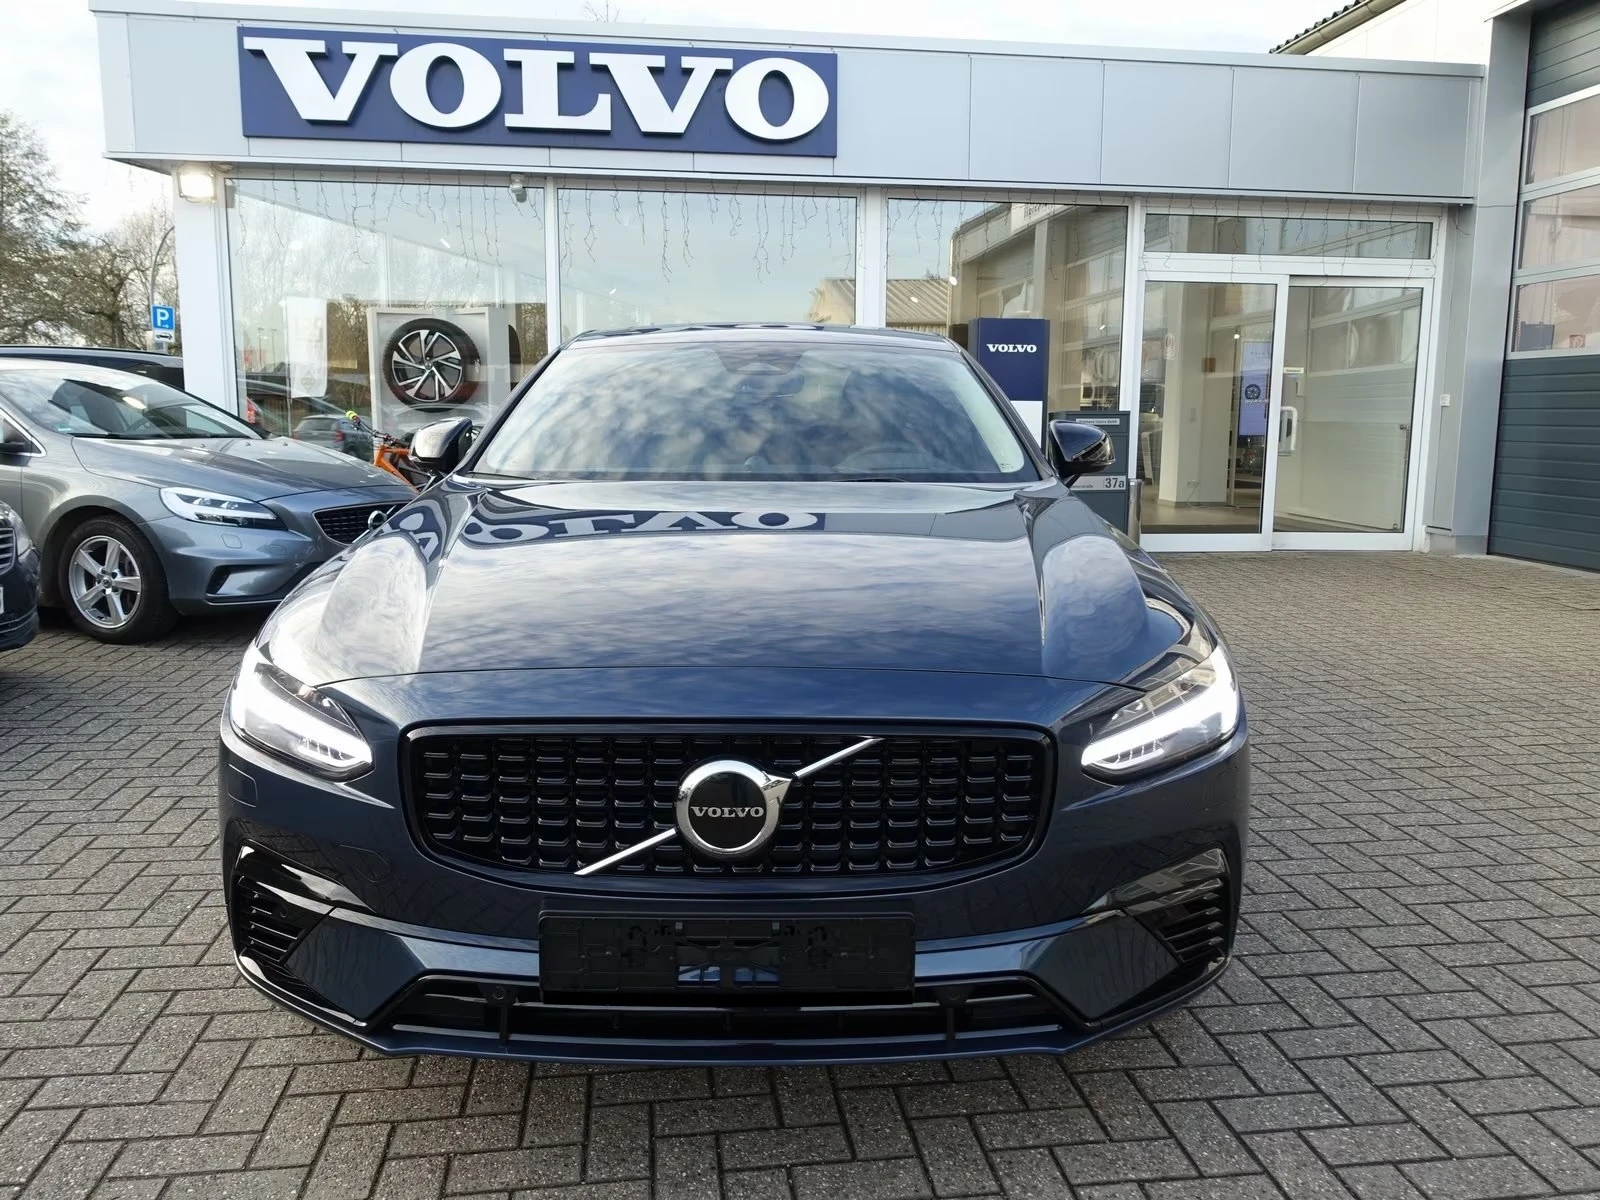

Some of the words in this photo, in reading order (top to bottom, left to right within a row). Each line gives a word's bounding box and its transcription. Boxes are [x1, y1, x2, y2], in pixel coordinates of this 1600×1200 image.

[243, 36, 829, 140] VOLVO
[157, 308, 169, 326] P
[986, 343, 1037, 353] VOLVO
[1105, 477, 1125, 488] 37a
[690, 806, 764, 818] VOLVO
